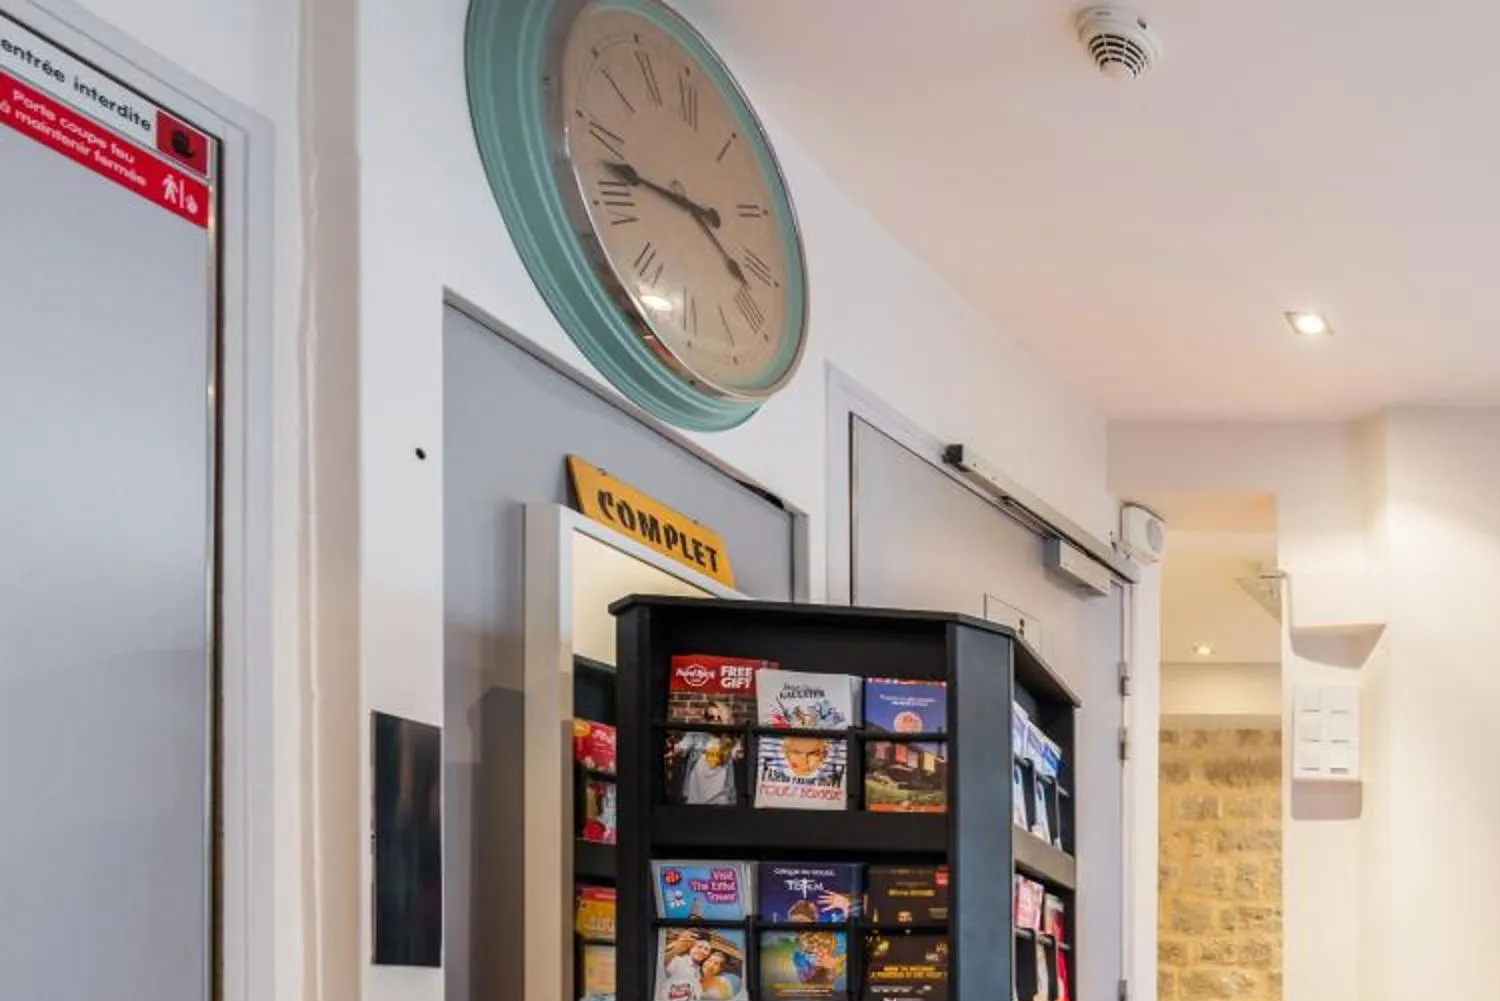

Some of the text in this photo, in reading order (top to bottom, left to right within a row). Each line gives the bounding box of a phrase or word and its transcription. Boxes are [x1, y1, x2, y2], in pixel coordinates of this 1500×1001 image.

[1, 38, 151, 132] entrée interdite
[12, 89, 135, 164] Porte coupe feu
[14, 109, 91, 157] maintenir
[93, 149, 147, 187] fermée
[597, 488, 718, 574] COMPLET
[721, 665, 753, 678] FREE
[721, 677, 752, 689] GIFT
